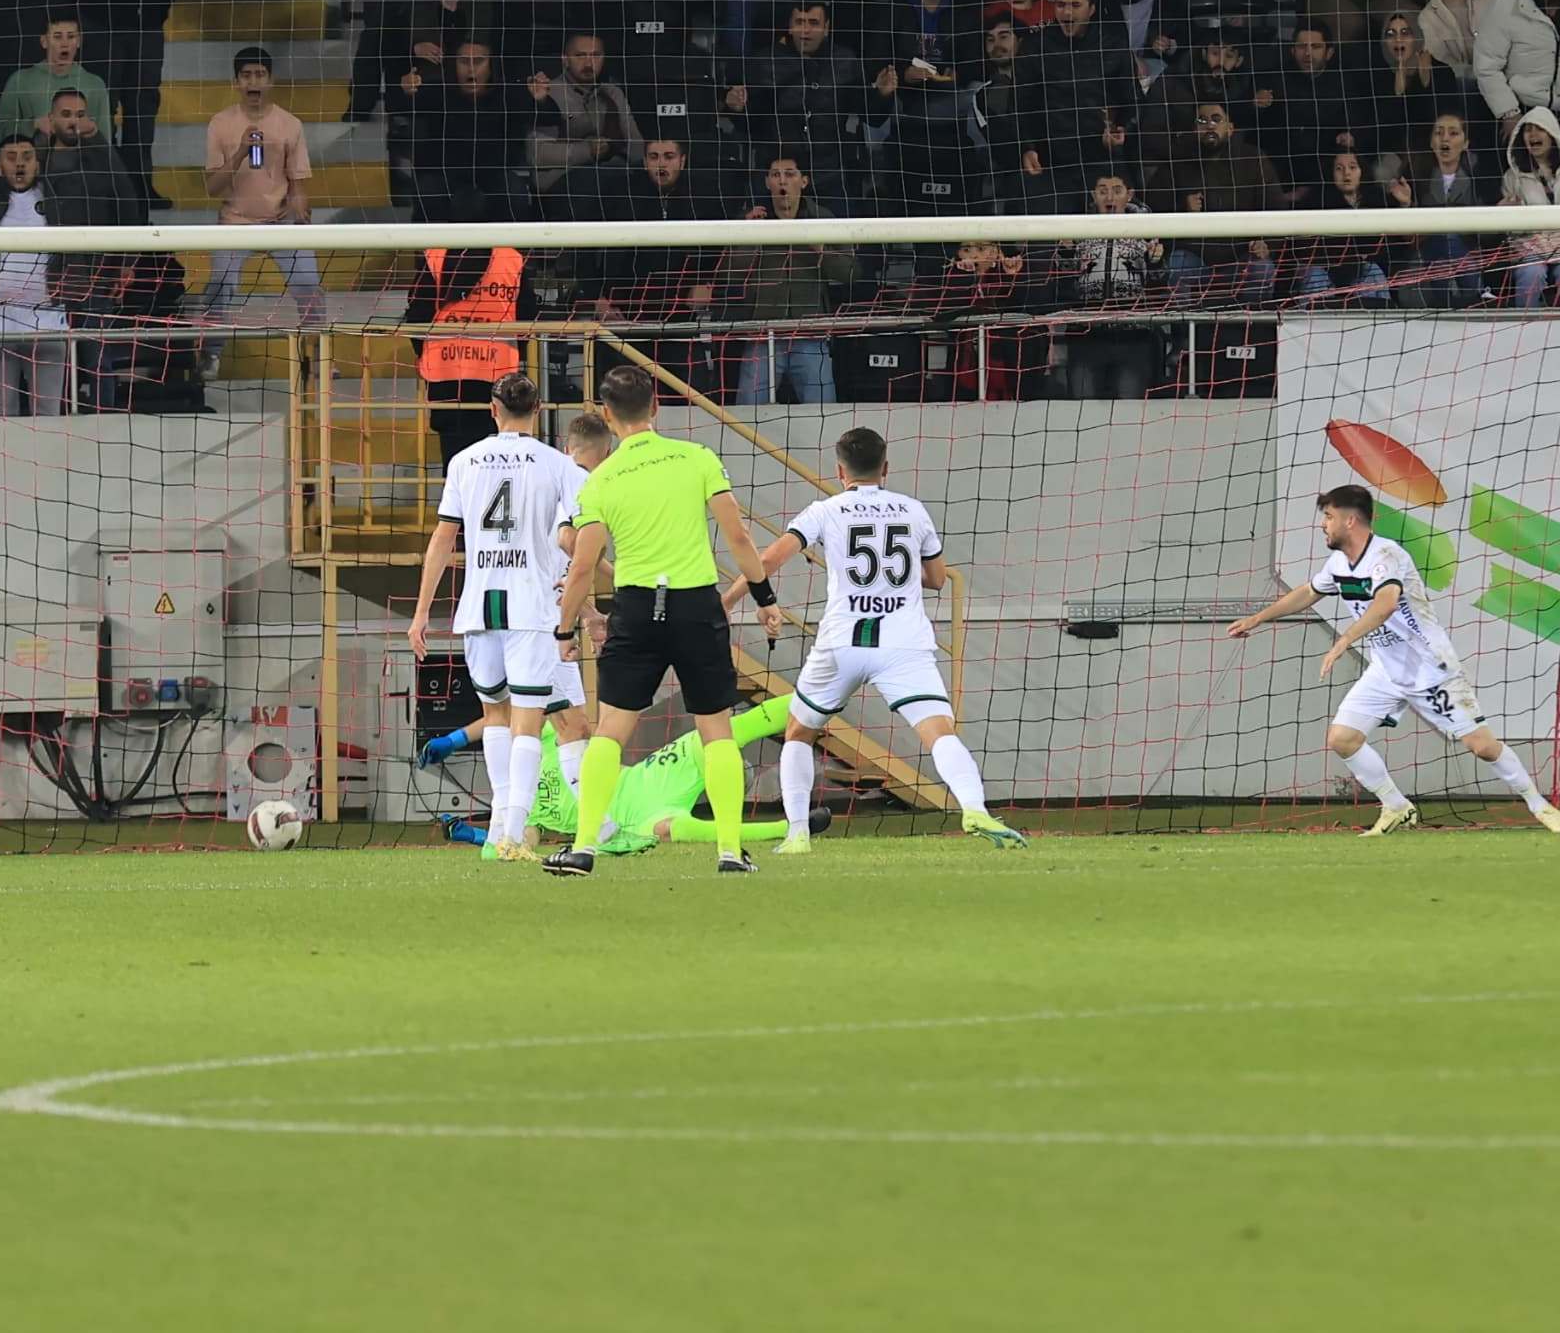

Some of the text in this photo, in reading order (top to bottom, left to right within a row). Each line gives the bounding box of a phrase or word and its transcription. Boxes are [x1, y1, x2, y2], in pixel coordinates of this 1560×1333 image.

[470, 452, 537, 466] KONAK
[480, 477, 518, 543] 4
[839, 502, 909, 514] KONAK
[845, 523, 912, 589] 55
[848, 595, 907, 614] YUSUF
